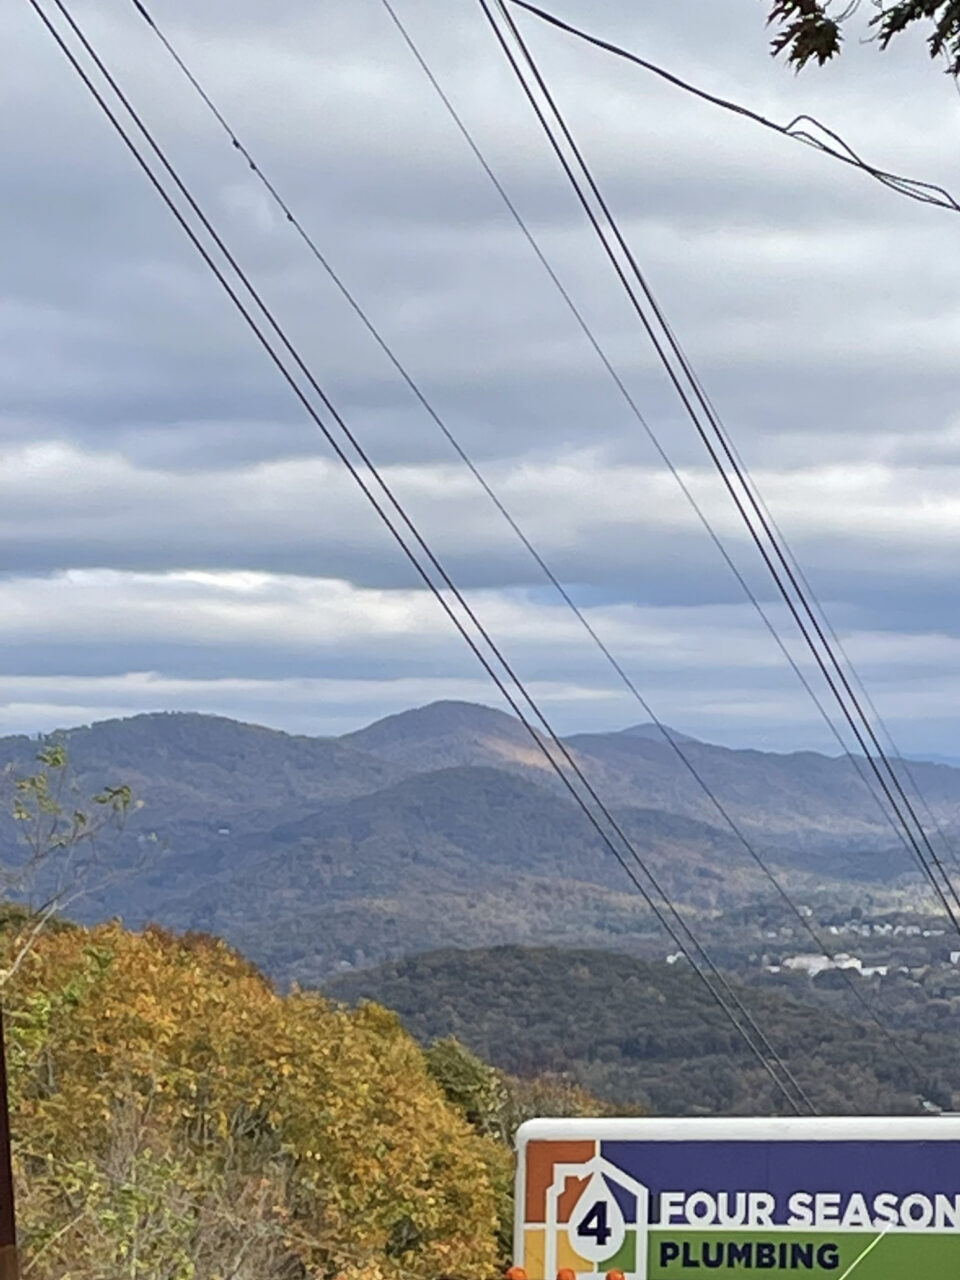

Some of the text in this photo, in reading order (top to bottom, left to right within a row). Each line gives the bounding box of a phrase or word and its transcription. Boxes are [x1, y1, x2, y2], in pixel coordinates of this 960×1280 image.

[576, 1201, 612, 1246] 4
[660, 1192, 776, 1227] FOUR
[659, 1241, 840, 1270] PLUMBING
